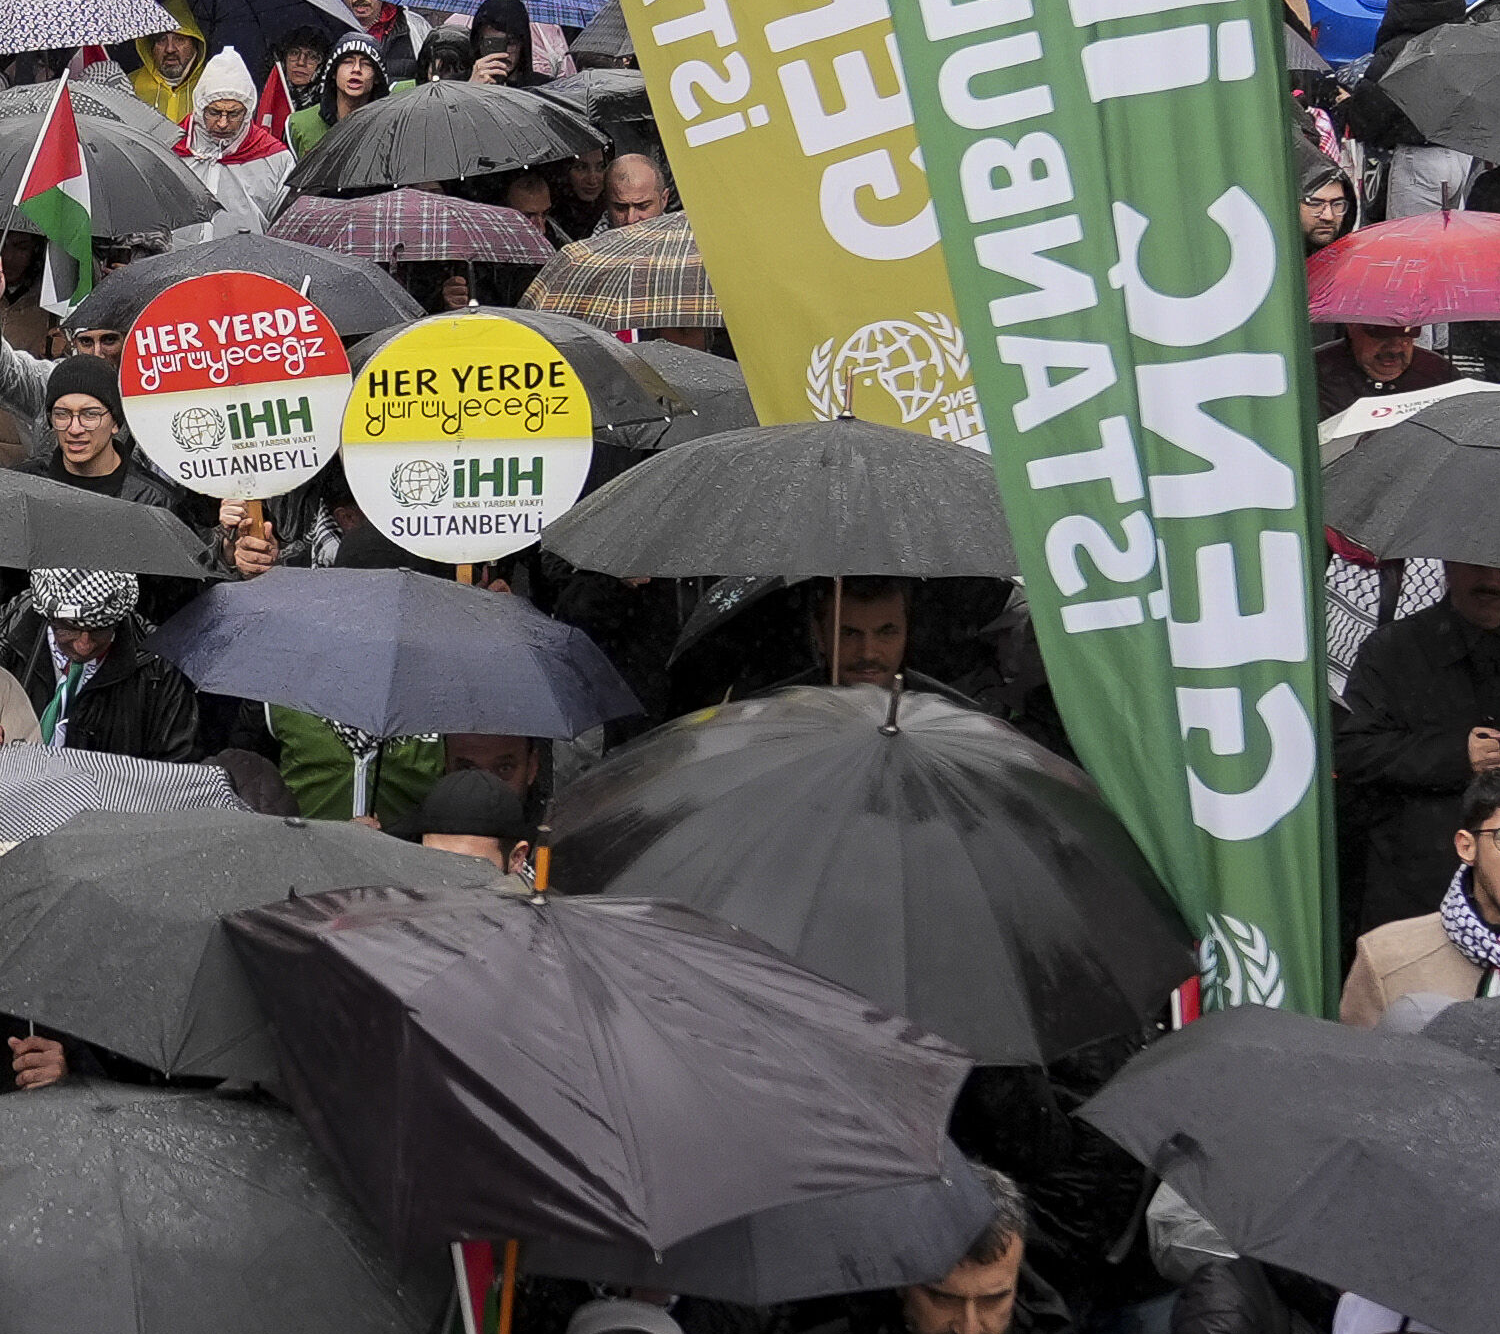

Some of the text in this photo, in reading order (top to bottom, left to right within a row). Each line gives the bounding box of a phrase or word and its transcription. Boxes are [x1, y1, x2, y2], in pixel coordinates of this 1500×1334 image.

[135, 304, 319, 355] HER YERDE
[136, 337, 326, 391] yürüyeceğiz
[367, 360, 566, 398] HER YERDE
[364, 393, 569, 437] yürüyeceğiz
